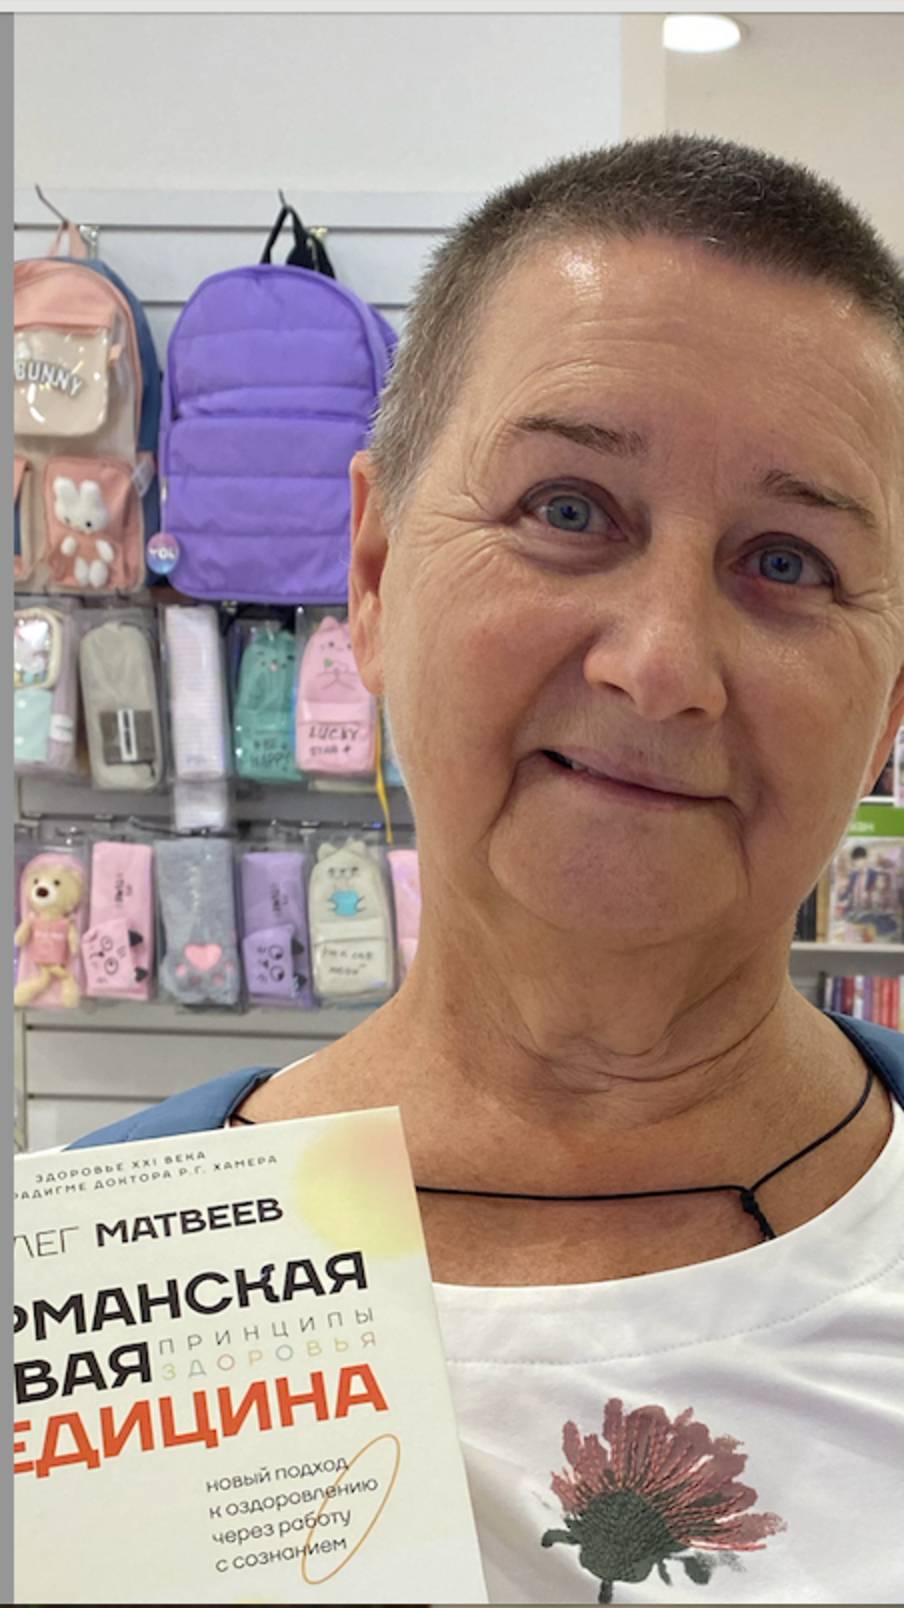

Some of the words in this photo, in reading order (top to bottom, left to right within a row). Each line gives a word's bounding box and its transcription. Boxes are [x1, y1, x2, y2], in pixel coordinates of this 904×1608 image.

[15, 360, 82, 396] BUNNY
[308, 725, 360, 741] LUCKY
[35, 1162, 124, 1184] ЗДОРОВЬЕ
[164, 1151, 206, 1165] ВЕКА
[94, 1169, 172, 1190] ДОКТОРА
[213, 1154, 278, 1172] ХАМЕРА
[95, 1197, 284, 1248] МАТВЕЕВ
[158, 1307, 375, 1356] ПРИНЦИПЫ
[14, 1341, 152, 1404] ВАЯ
[161, 1331, 377, 1381] ЗДОРОВЬЯ
[206, 1467, 271, 1493] новый
[275, 1457, 349, 1481] подход
[209, 1505, 222, 1519] к
[225, 1478, 379, 1517] оздоровлению
[212, 1523, 275, 1546] через
[279, 1510, 351, 1538] работу
[215, 1559, 229, 1573] с
[232, 1537, 347, 1570] сознанием
